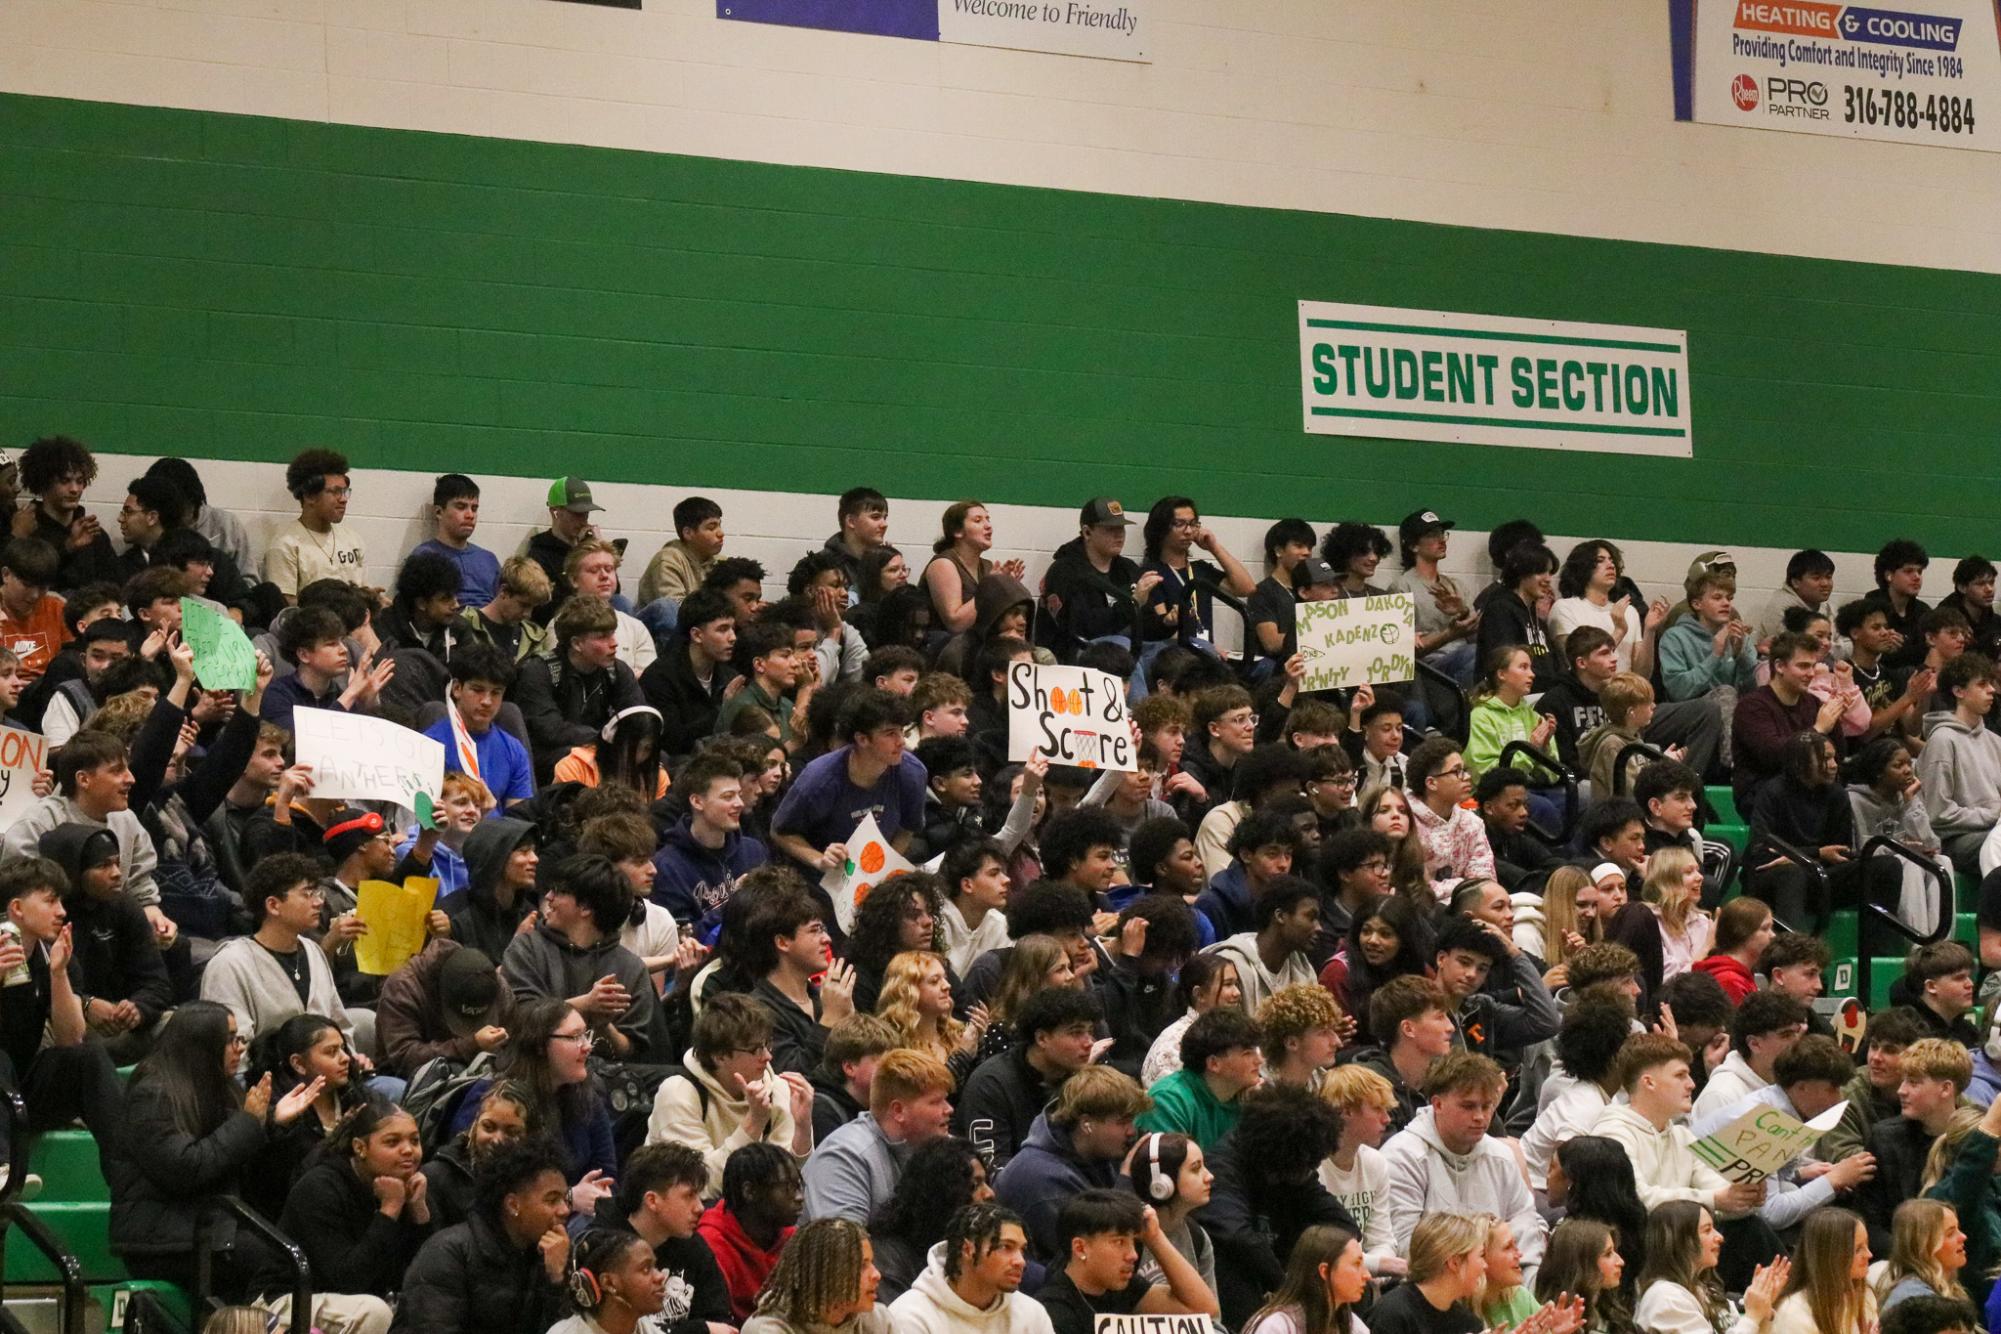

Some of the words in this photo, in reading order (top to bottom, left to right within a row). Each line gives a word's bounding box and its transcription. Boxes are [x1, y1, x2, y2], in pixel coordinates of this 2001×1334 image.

[953, 0, 1037, 20] Welcome
[1042, 4, 1060, 23] to
[1065, 2, 1137, 36] Friendly
[1742, 5, 1831, 29] HEATING
[1844, 15, 1860, 32] &
[1867, 17, 1955, 43] COOLING
[1732, 33, 1786, 67] Providing
[1788, 41, 1832, 65] Comfort
[1835, 48, 1855, 67] and
[1857, 50, 1904, 79] Integrity
[1906, 52, 1934, 76] Since
[1936, 56, 1963, 79] 1984
[1733, 79, 1759, 105] Rheem
[1767, 76, 1828, 106] PRO
[1844, 85, 1975, 134] 316-788-4884
[1769, 104, 1830, 121] PARTNER
[1312, 343, 1499, 406] STUDENT
[1511, 356, 1679, 418] SECTION
[1296, 599, 1349, 637] MASON
[1364, 595, 1415, 628] DAKOTA
[1366, 653, 1414, 683] JORDYN
[1010, 662, 1095, 717] Shoot
[1103, 676, 1124, 722] &
[0, 731, 43, 772] ON
